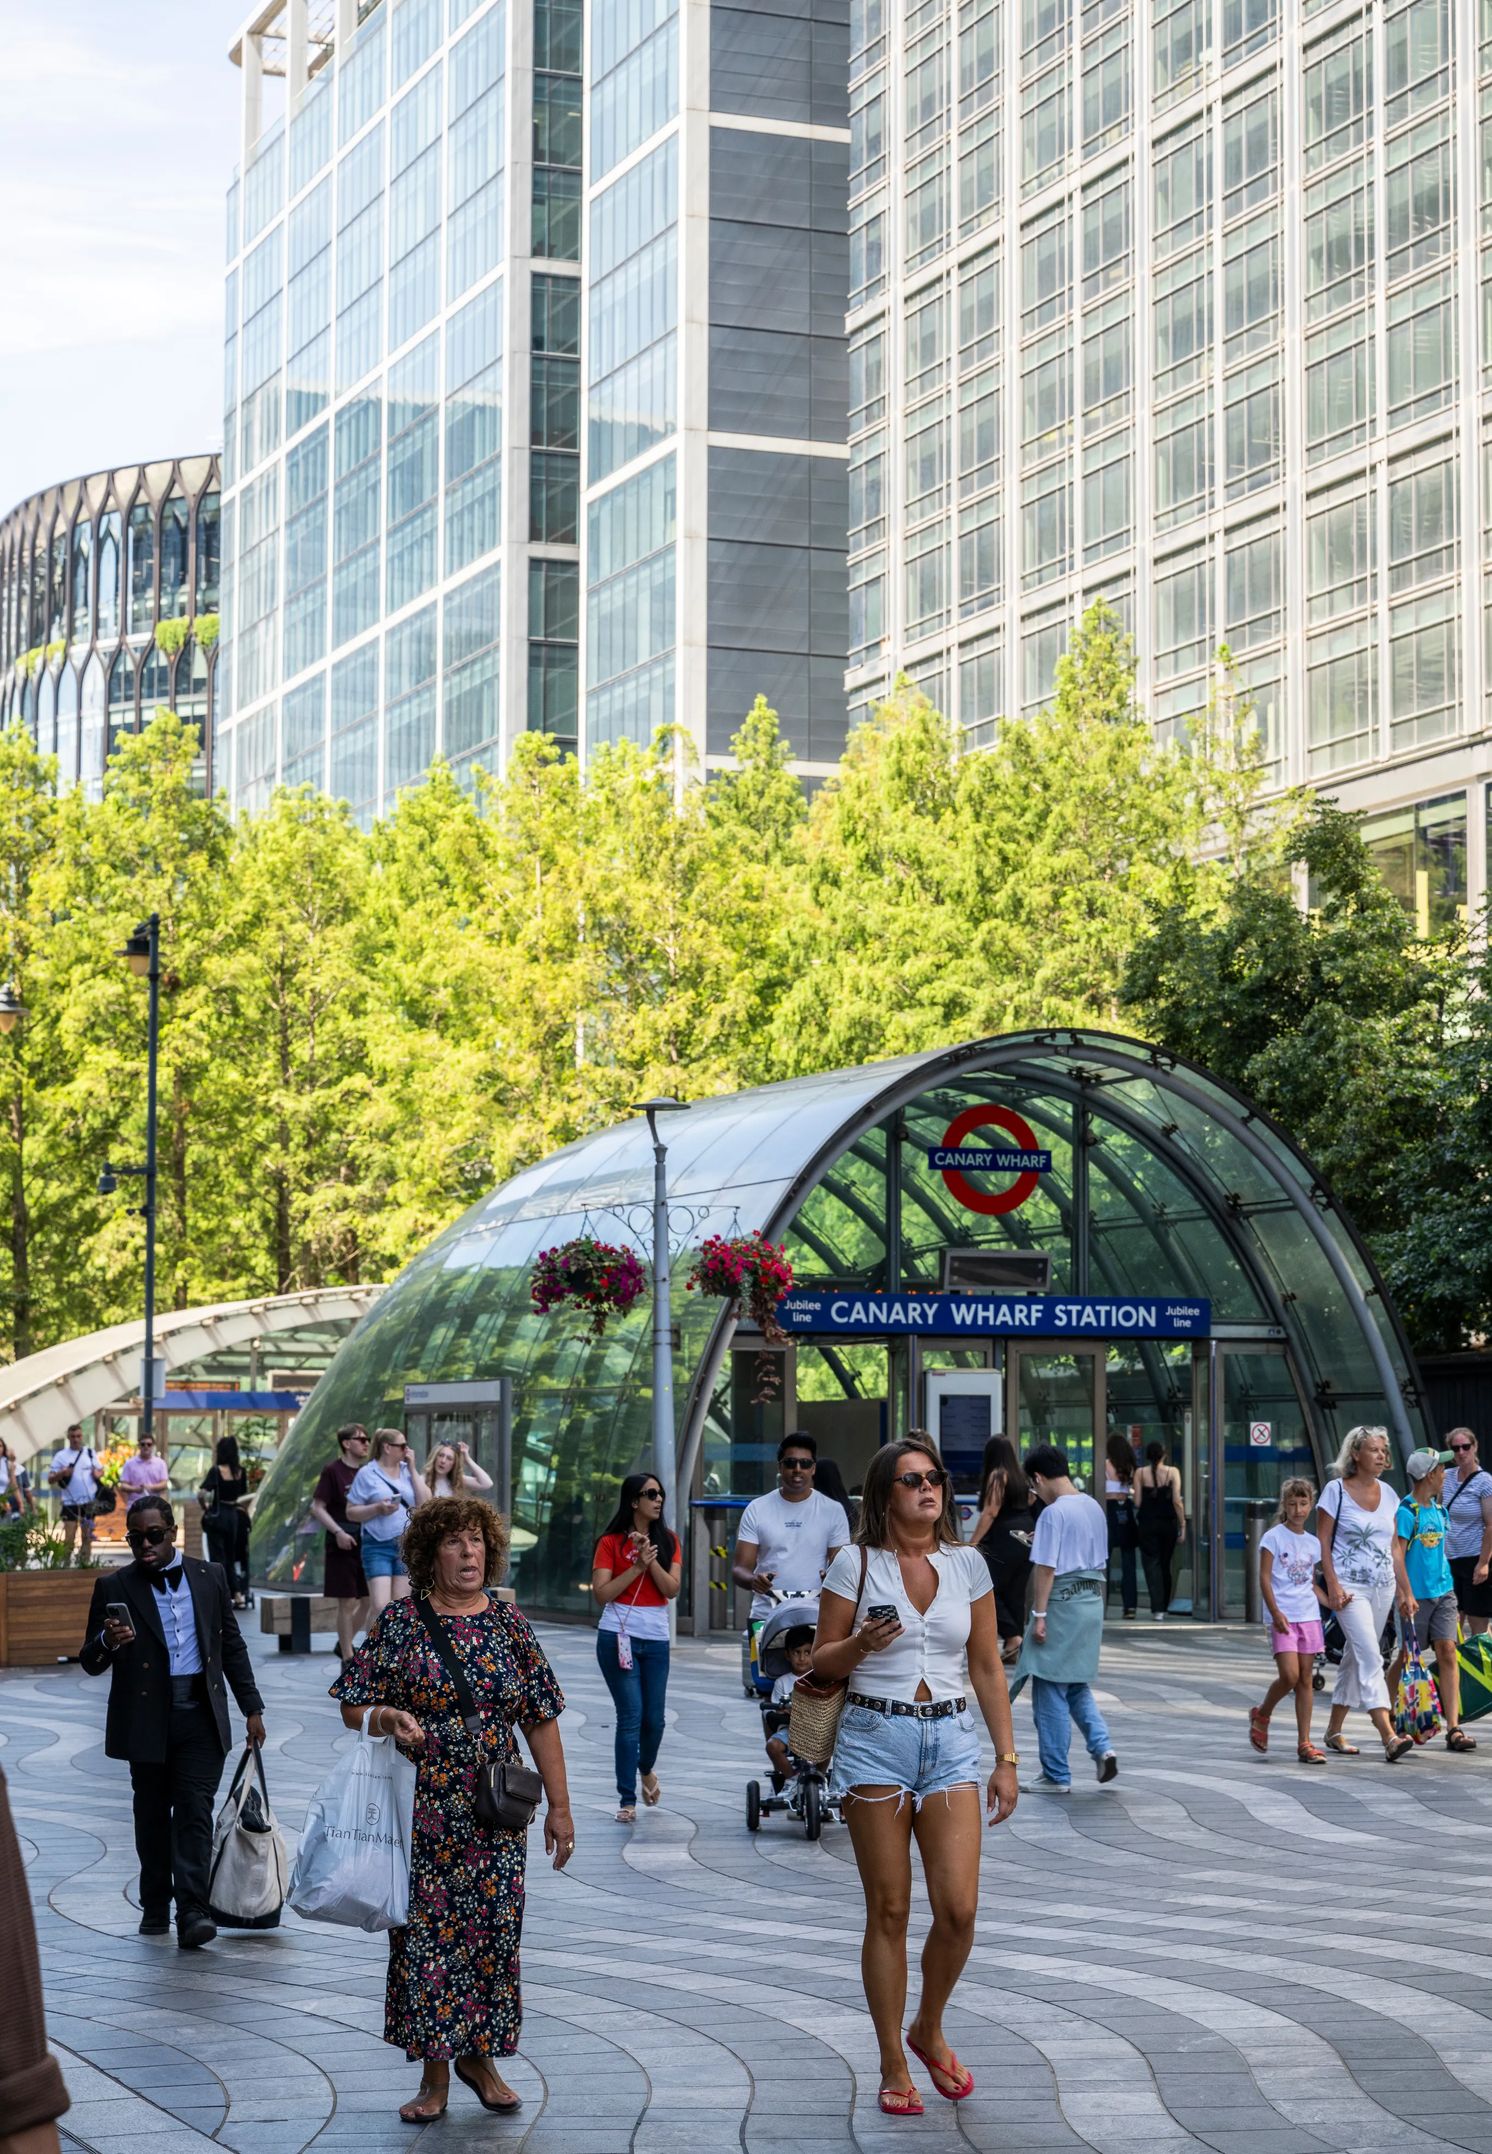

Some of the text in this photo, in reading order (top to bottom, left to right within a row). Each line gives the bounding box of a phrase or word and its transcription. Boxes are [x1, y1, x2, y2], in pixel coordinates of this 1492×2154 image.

[934, 1152, 1047, 1168] CANARY WHARF
[784, 1300, 821, 1311] Jubilee
[1165, 1306, 1200, 1316] Jubilee
[793, 1312, 812, 1322] line
[830, 1301, 1156, 1327] CANARY WHARF STATION
[1174, 1317, 1192, 1328] line
